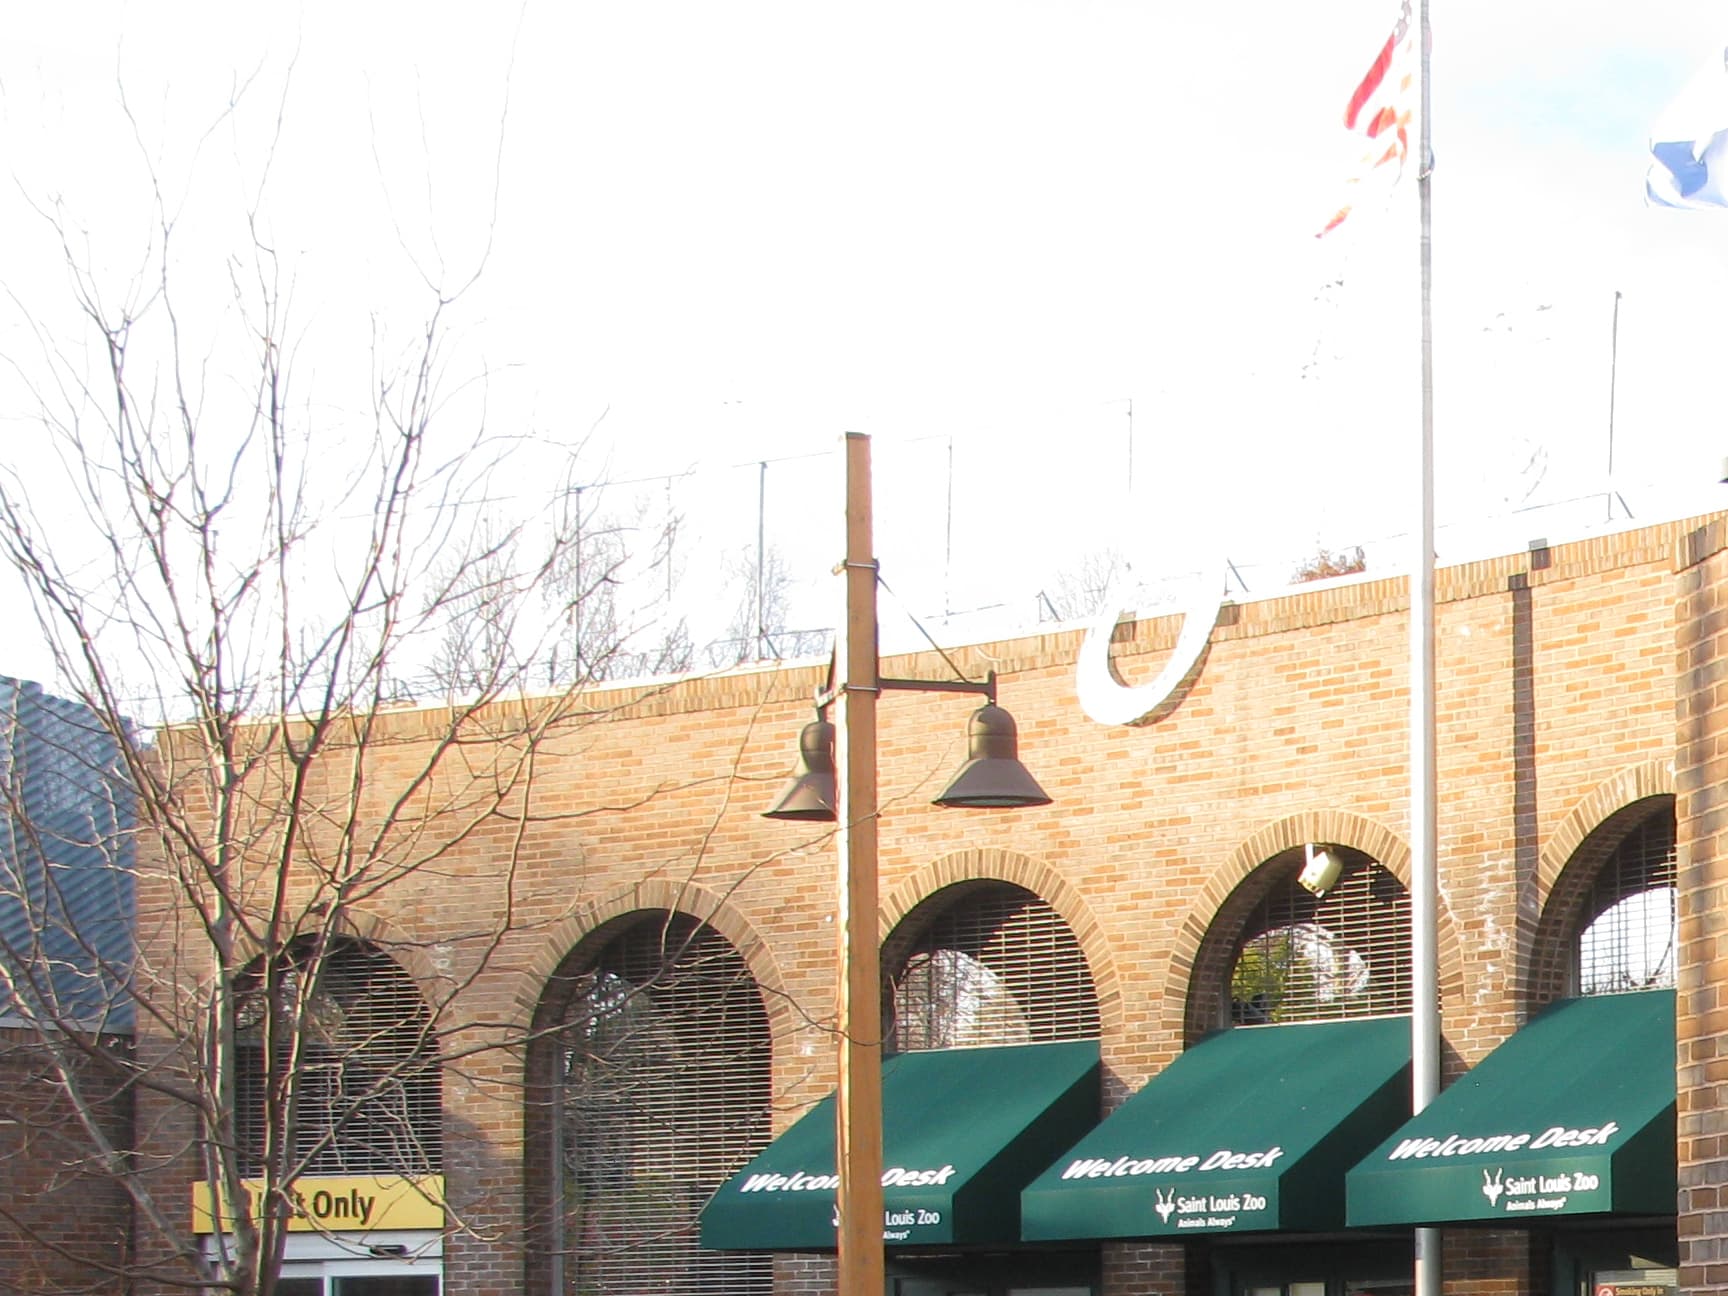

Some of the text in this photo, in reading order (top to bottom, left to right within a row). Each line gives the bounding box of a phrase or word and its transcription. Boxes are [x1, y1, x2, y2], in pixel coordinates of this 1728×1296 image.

[1389, 1121, 1620, 1160] Welcome Desk
[1061, 1146, 1284, 1180] Welcome Desk
[740, 1165, 956, 1192] Welco Desk
[1505, 1172, 1599, 1196] Saint Louis Zoo
[313, 1188, 376, 1225] Only
[1177, 1193, 1266, 1214] Saint Louis Zoo
[885, 1209, 940, 1226] Louis Zoo
